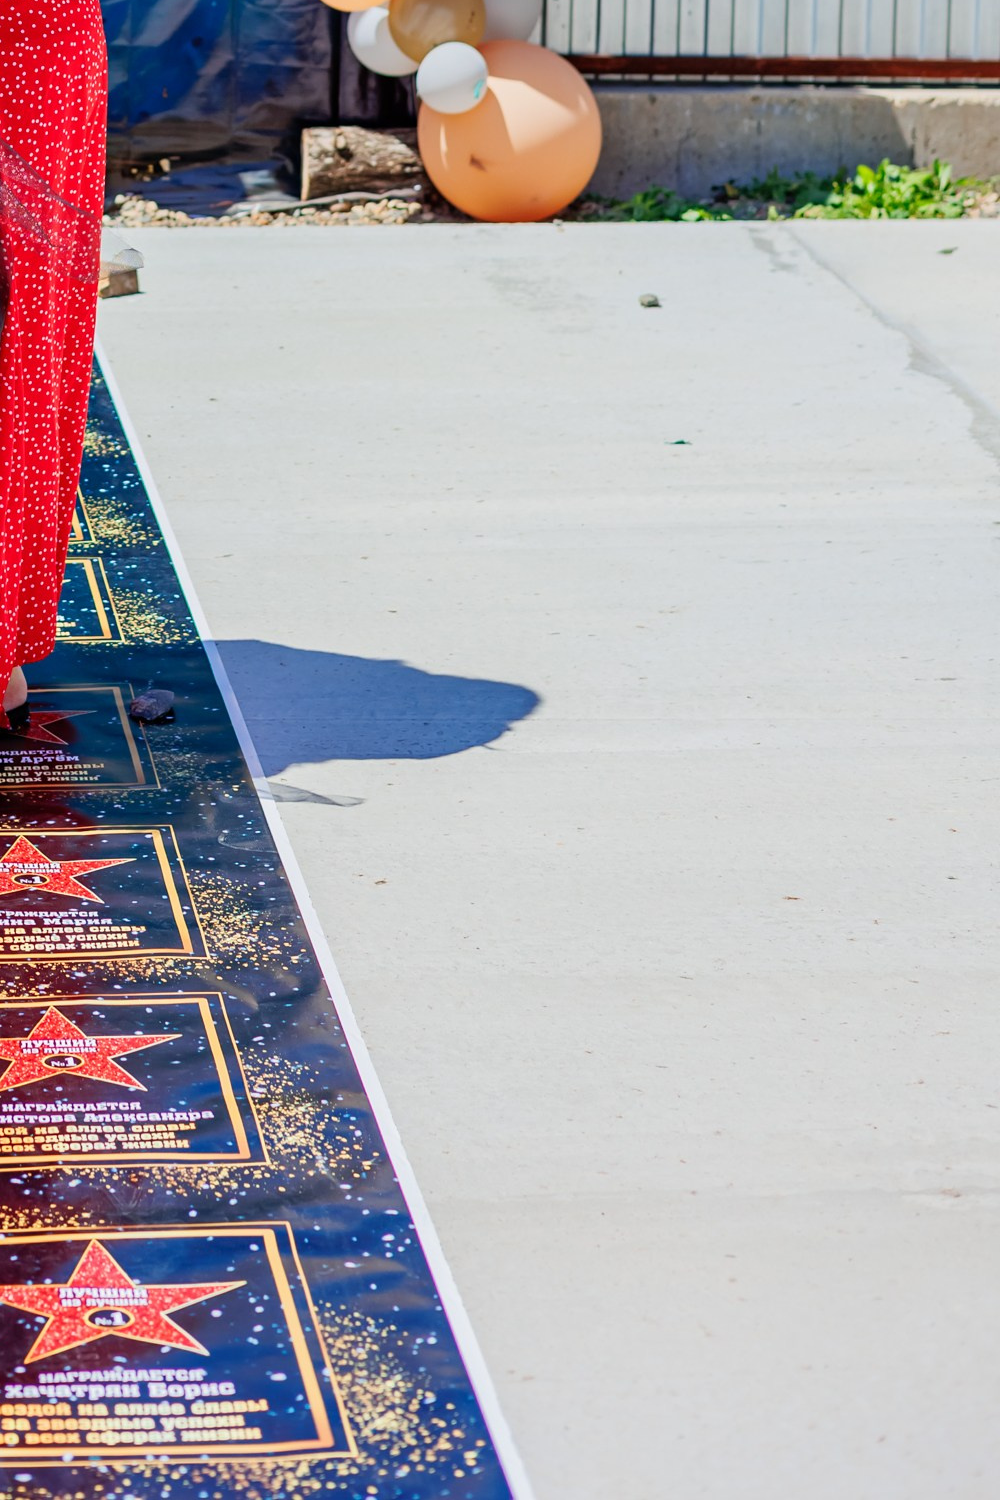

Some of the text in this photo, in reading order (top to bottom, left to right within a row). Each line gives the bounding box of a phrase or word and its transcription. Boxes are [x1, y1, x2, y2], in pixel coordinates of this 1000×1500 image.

[20, 754, 80, 763] Артём
[43, 917, 112, 926] Мария
[83, 1111, 214, 1122] Александра
[4, 1382, 235, 1399] Хачатрян Борис
